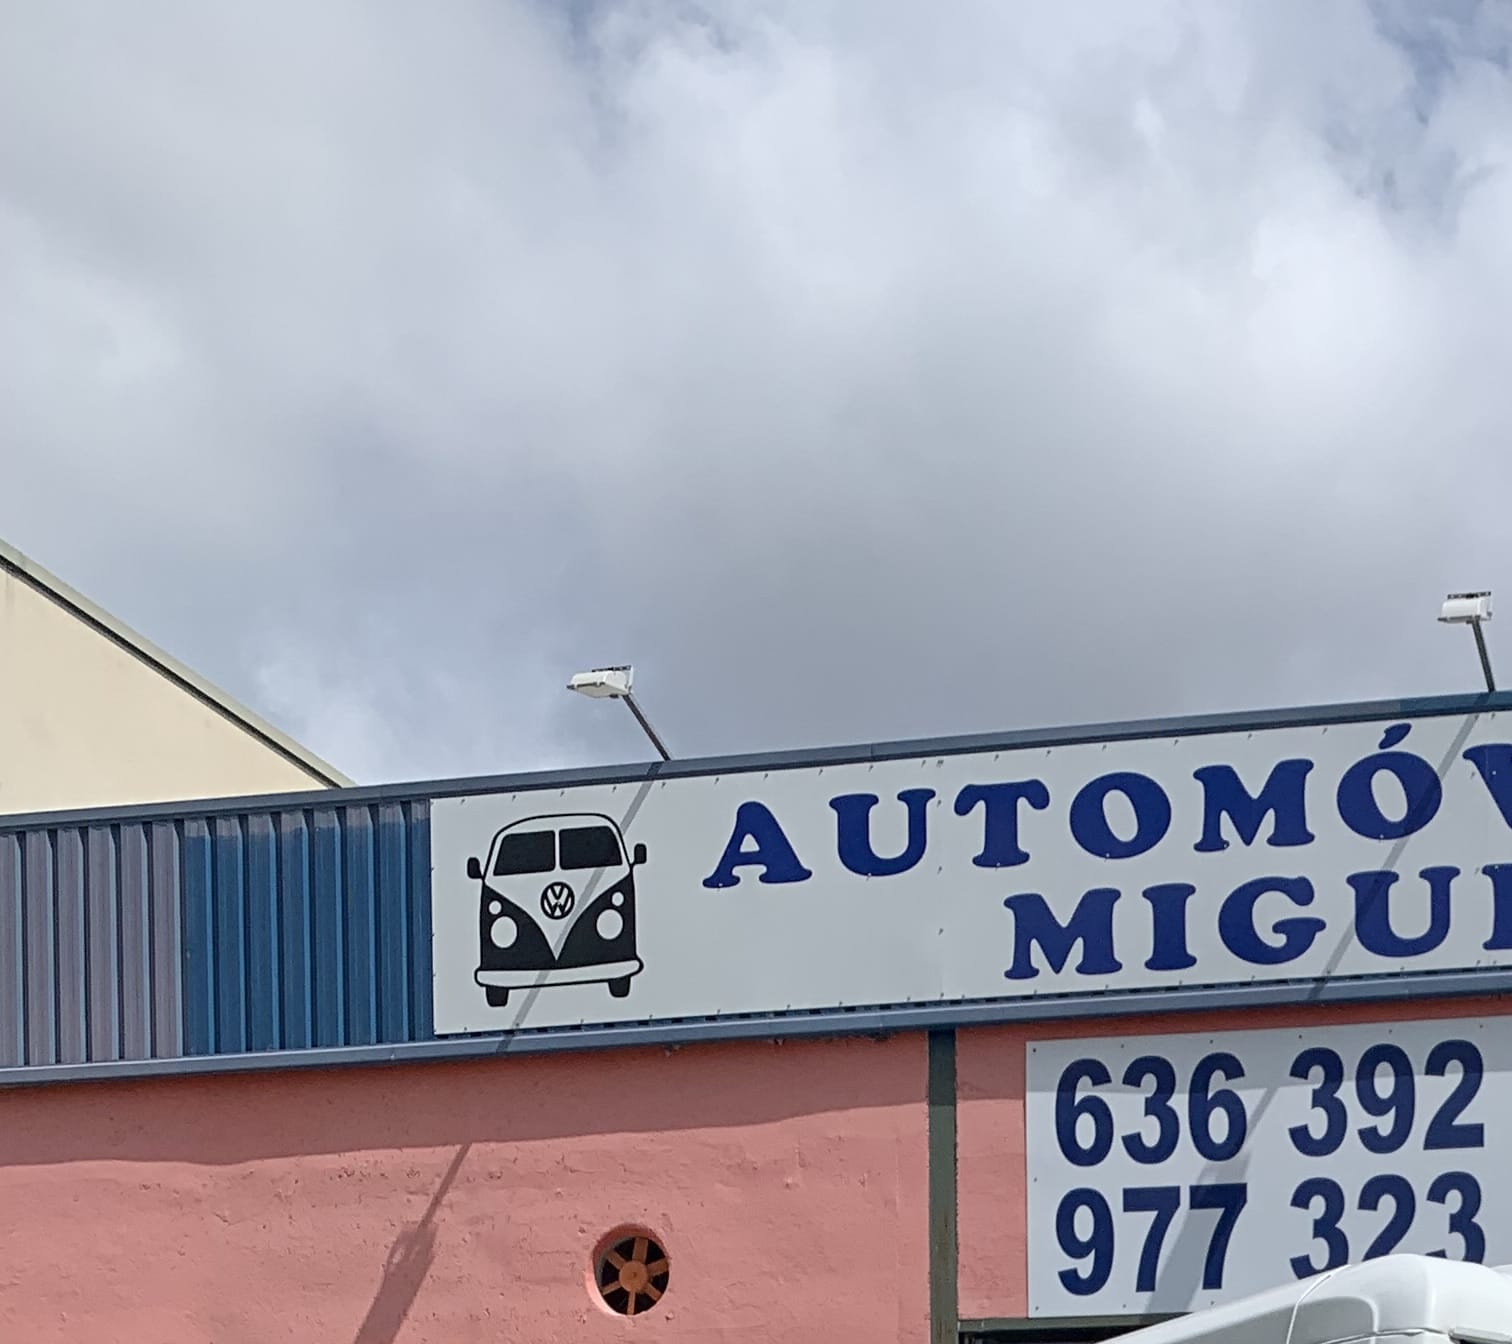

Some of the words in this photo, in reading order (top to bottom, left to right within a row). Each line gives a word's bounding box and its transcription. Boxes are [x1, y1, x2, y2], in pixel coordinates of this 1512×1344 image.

[1055, 1051, 1248, 1167] 636
[1288, 1039, 1485, 1157] 392
[1055, 1182, 1248, 1296] 977
[1289, 1171, 1486, 1280] 323
